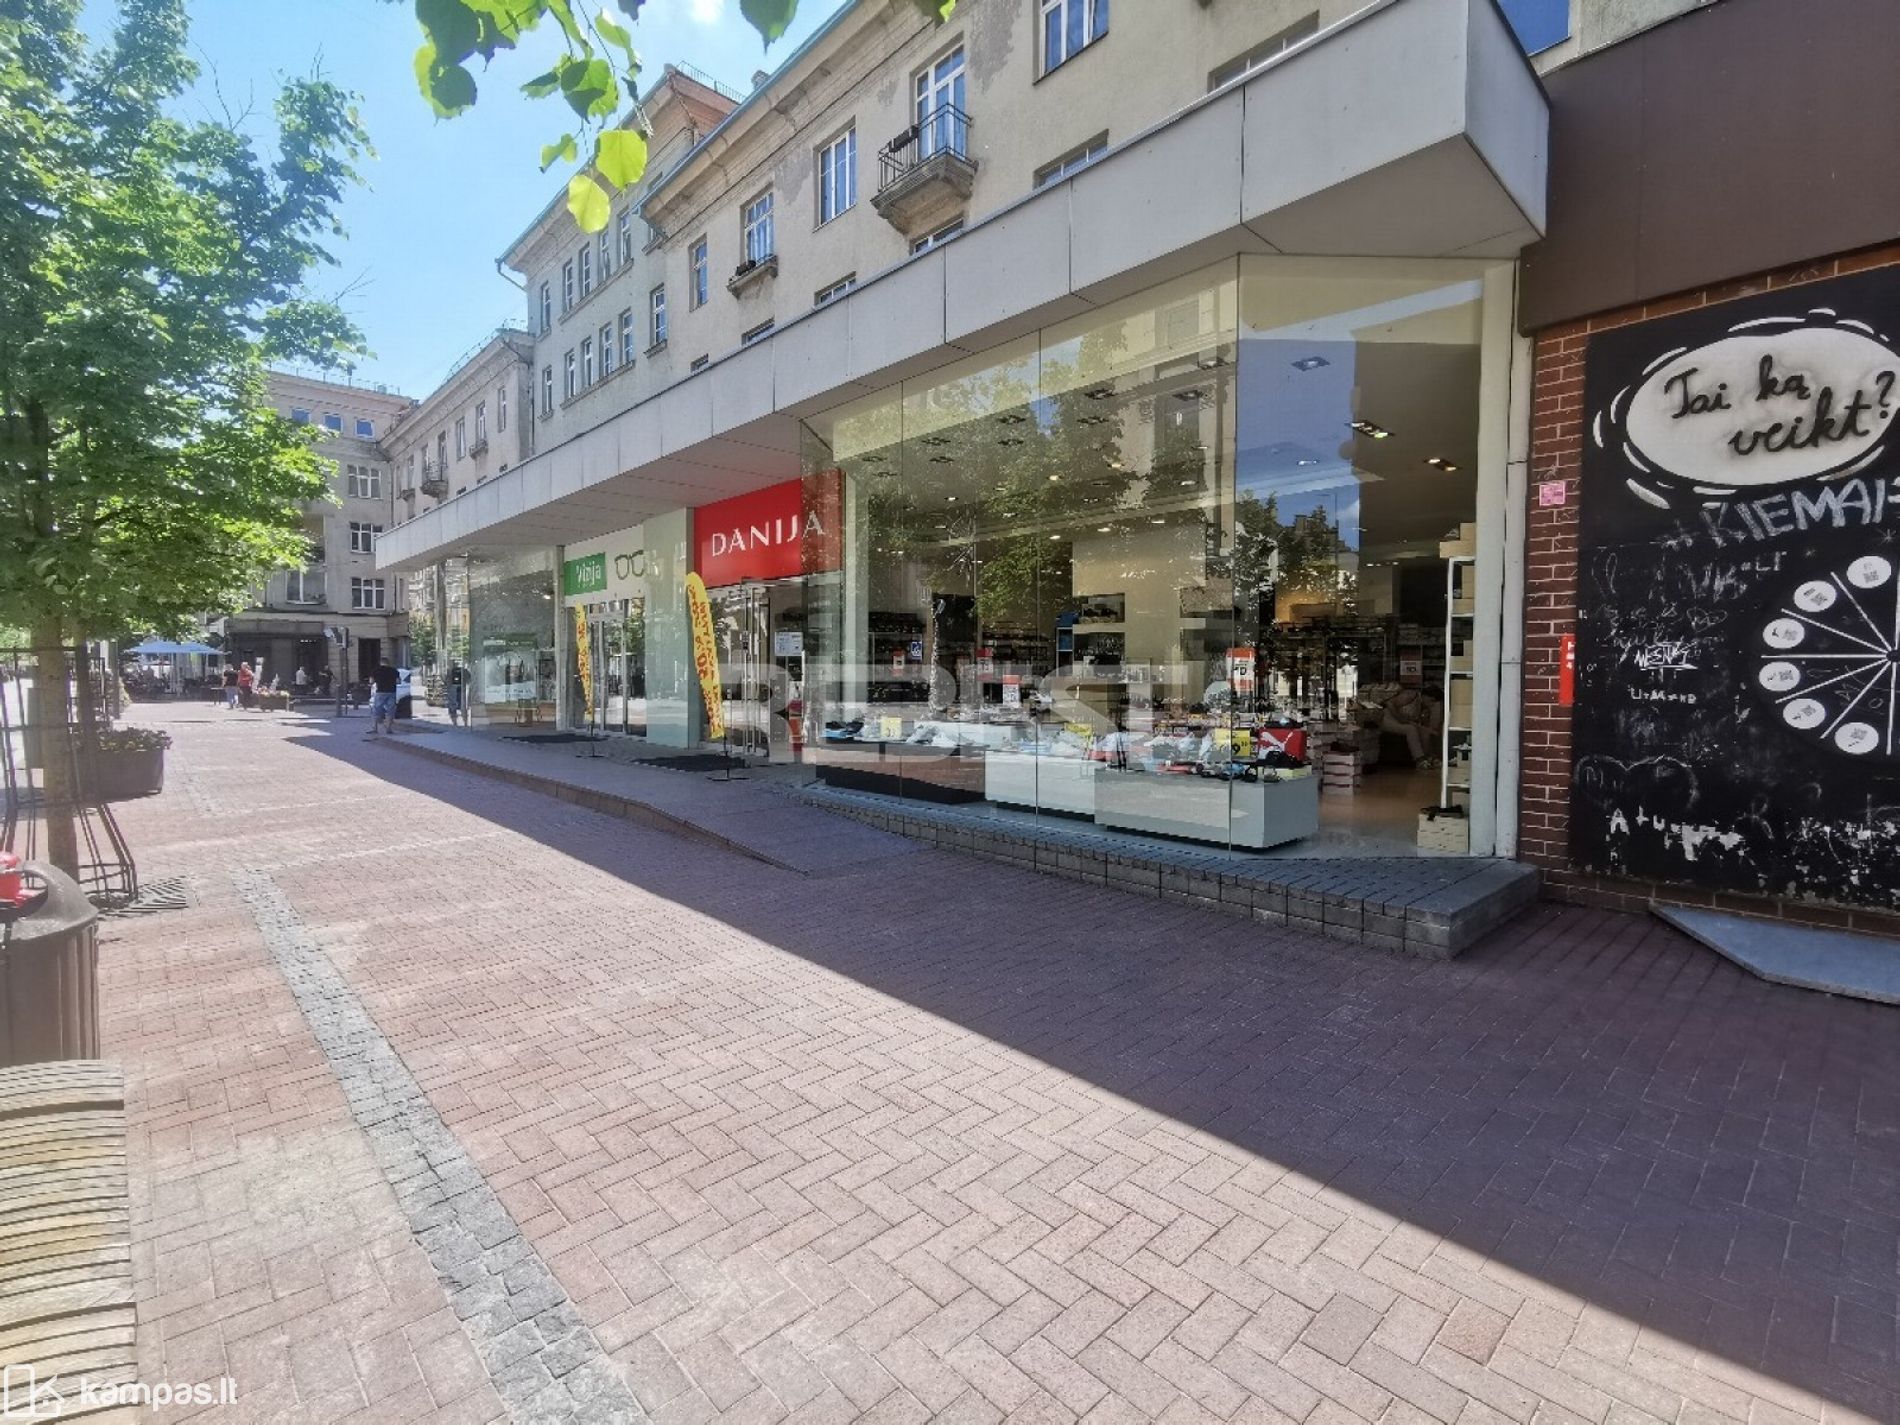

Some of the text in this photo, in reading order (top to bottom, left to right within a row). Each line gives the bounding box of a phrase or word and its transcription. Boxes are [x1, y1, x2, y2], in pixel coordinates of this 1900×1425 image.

[1663, 367, 1733, 419] Tai
[1727, 370, 1897, 456] veikt?
[711, 509, 826, 557] DANIJA
